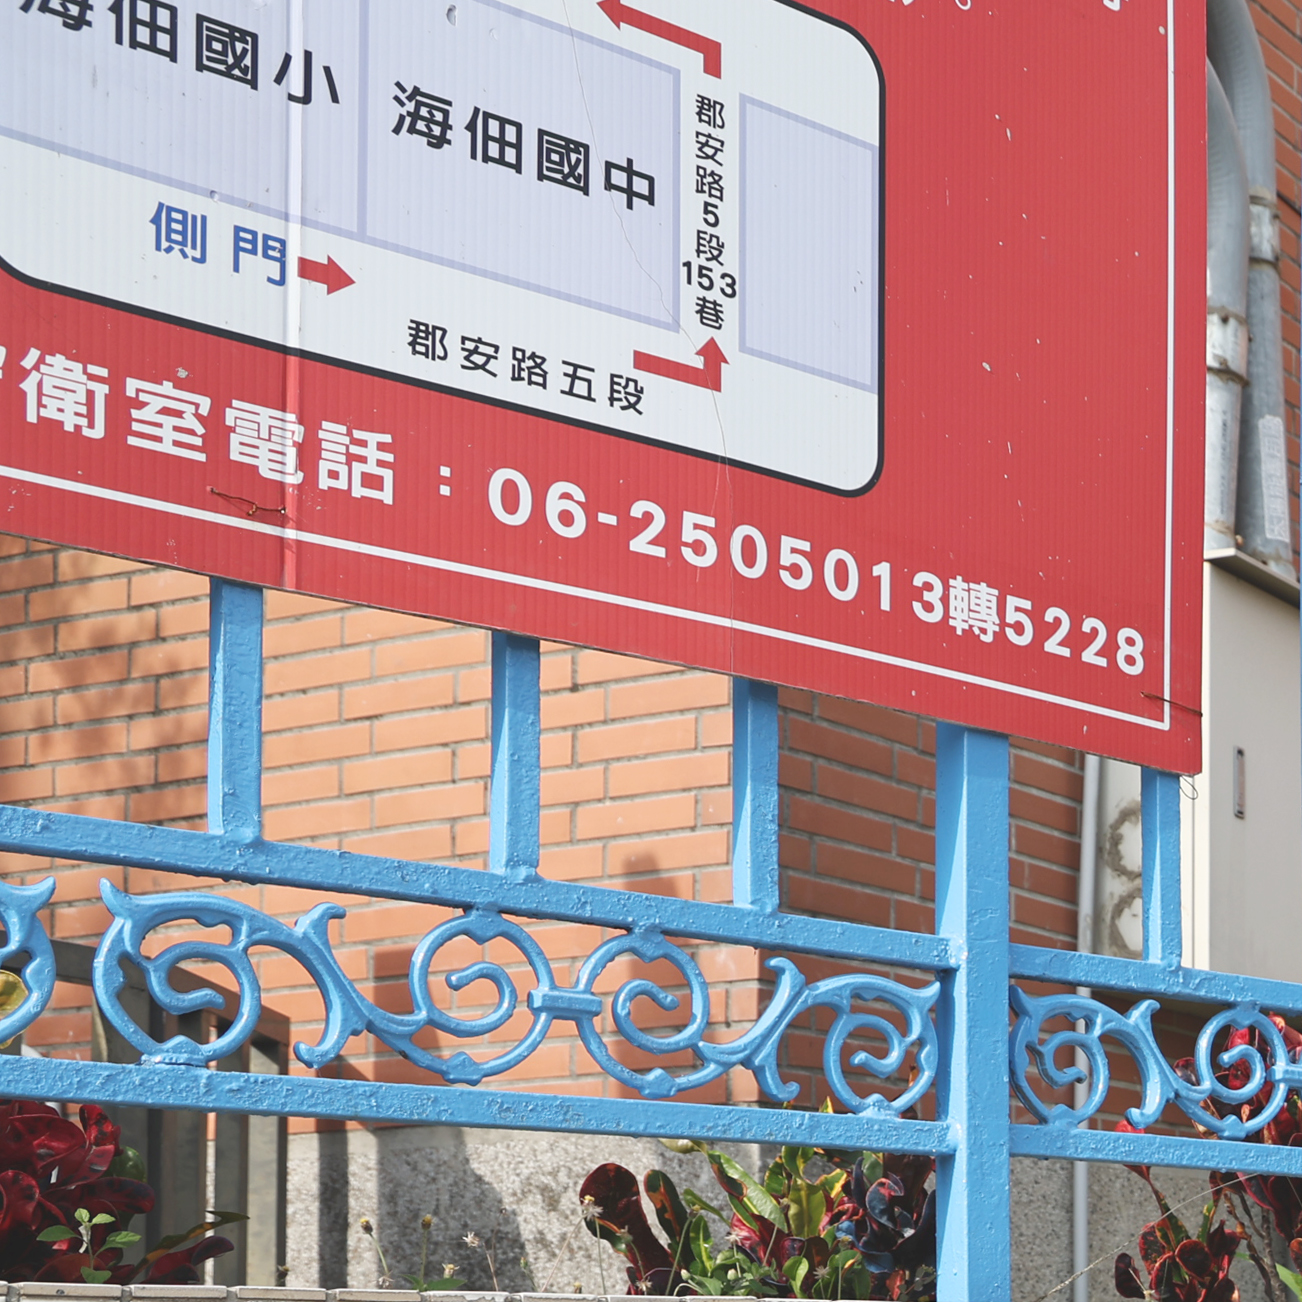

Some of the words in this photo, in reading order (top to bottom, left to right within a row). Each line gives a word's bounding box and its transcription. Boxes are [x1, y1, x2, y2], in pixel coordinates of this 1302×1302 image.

[391, 80, 656, 211] 海佃國中
[149, 200, 287, 287] 側門
[406, 318, 645, 416] 郡安路五段
